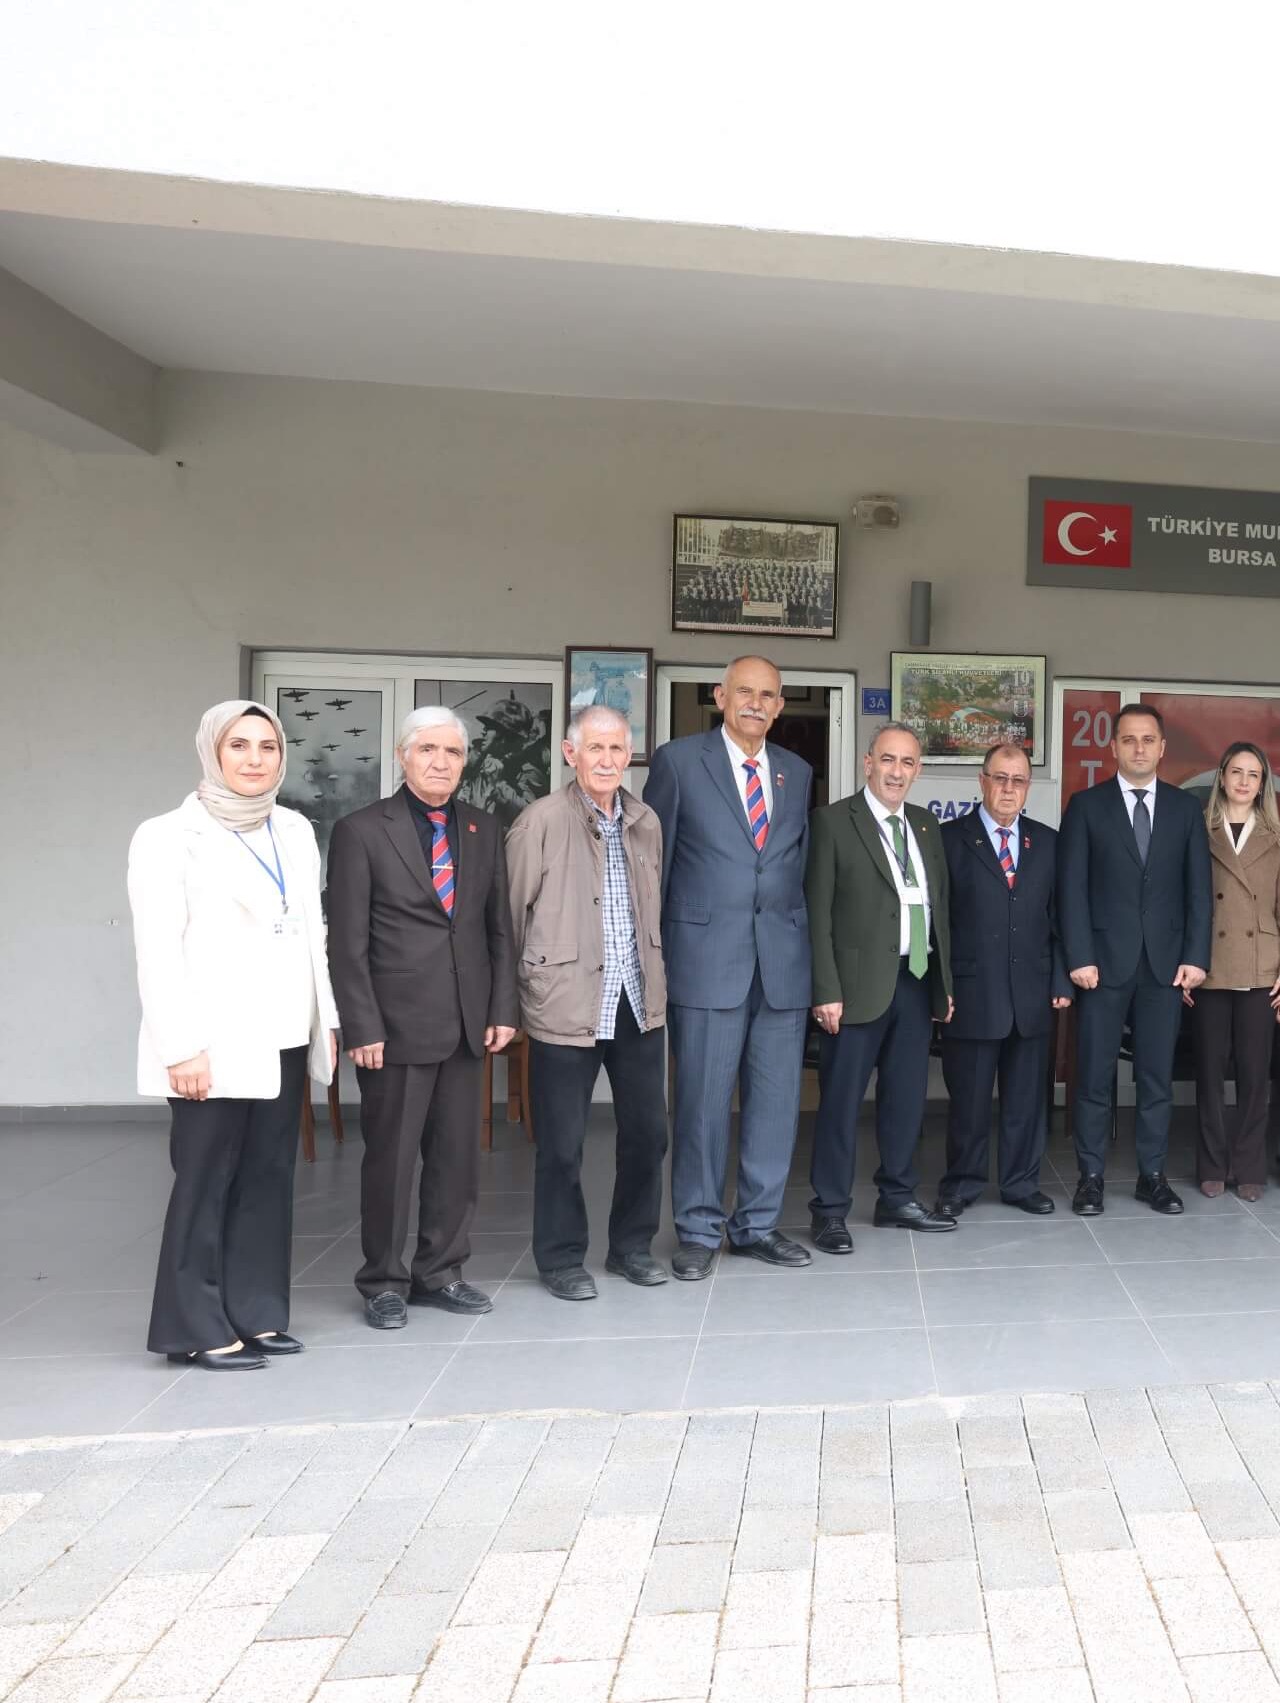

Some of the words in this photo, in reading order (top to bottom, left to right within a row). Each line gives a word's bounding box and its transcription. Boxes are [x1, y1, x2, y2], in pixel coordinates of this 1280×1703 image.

[1147, 514, 1239, 538] TÜRKİYE
[1208, 548, 1277, 567] BURSA
[869, 696, 886, 709] 3A
[1072, 710, 1112, 748] 20
